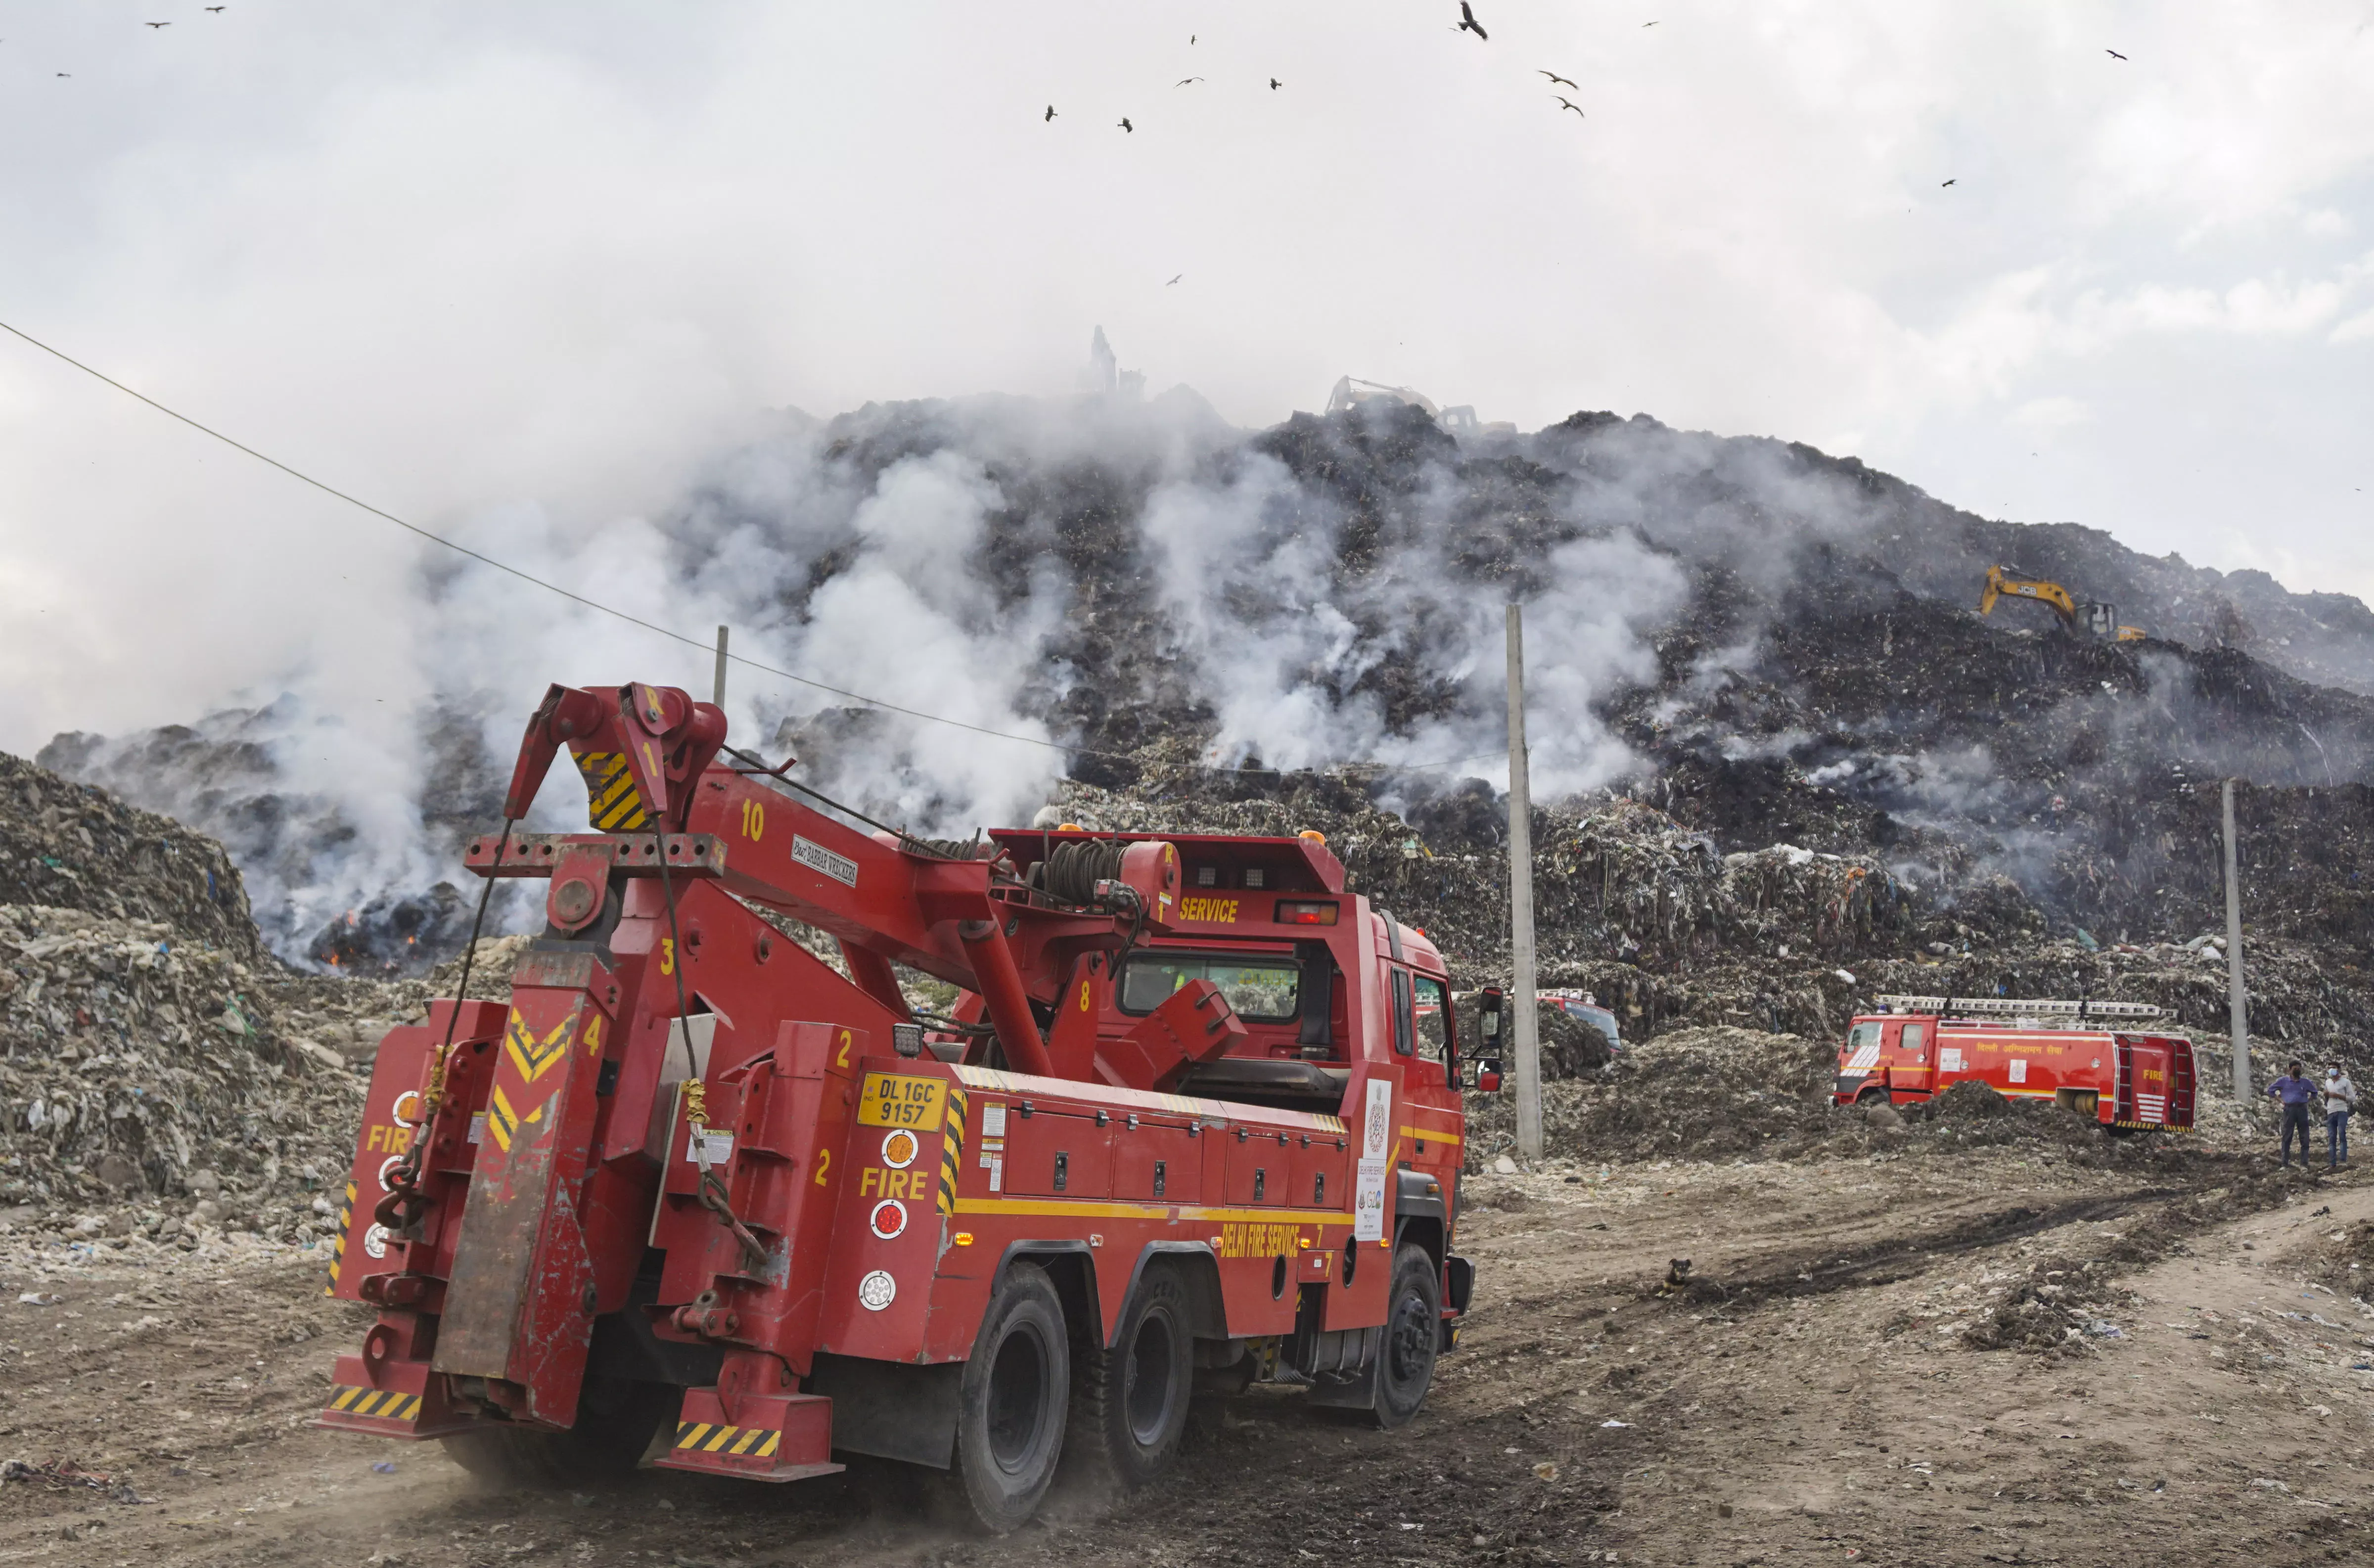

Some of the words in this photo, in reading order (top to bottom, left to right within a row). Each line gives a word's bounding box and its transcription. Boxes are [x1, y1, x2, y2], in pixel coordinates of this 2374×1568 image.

[2018, 585, 2037, 595] JCB
[643, 742, 658, 777] 1
[742, 798, 764, 842] 10
[807, 846, 827, 871] BABBAR
[828, 856, 856, 883] WRECKERS
[1165, 843, 1174, 863] R
[1179, 897, 1239, 923] SERVICE
[661, 938, 674, 975] 3
[1080, 981, 1090, 1012] 8
[583, 1014, 602, 1057] 4
[836, 1030, 852, 1068] 2
[2047, 1044, 2063, 1055] सेवा
[2143, 1069, 2163, 1081] FIRE
[879, 1079, 899, 1099] DL
[905, 1082, 935, 1103] 1GC
[881, 1102, 925, 1124] 9157
[366, 1124, 411, 1154] FIR
[815, 1149, 830, 1186] 2
[860, 1167, 928, 1201] FIRE
[1221, 1223, 1247, 1257] DELHI
[1247, 1224, 1267, 1257] FIRE
[1267, 1224, 1300, 1258] SERVICE
[1317, 1224, 1323, 1248] 7
[1325, 1252, 1333, 1277] 7
